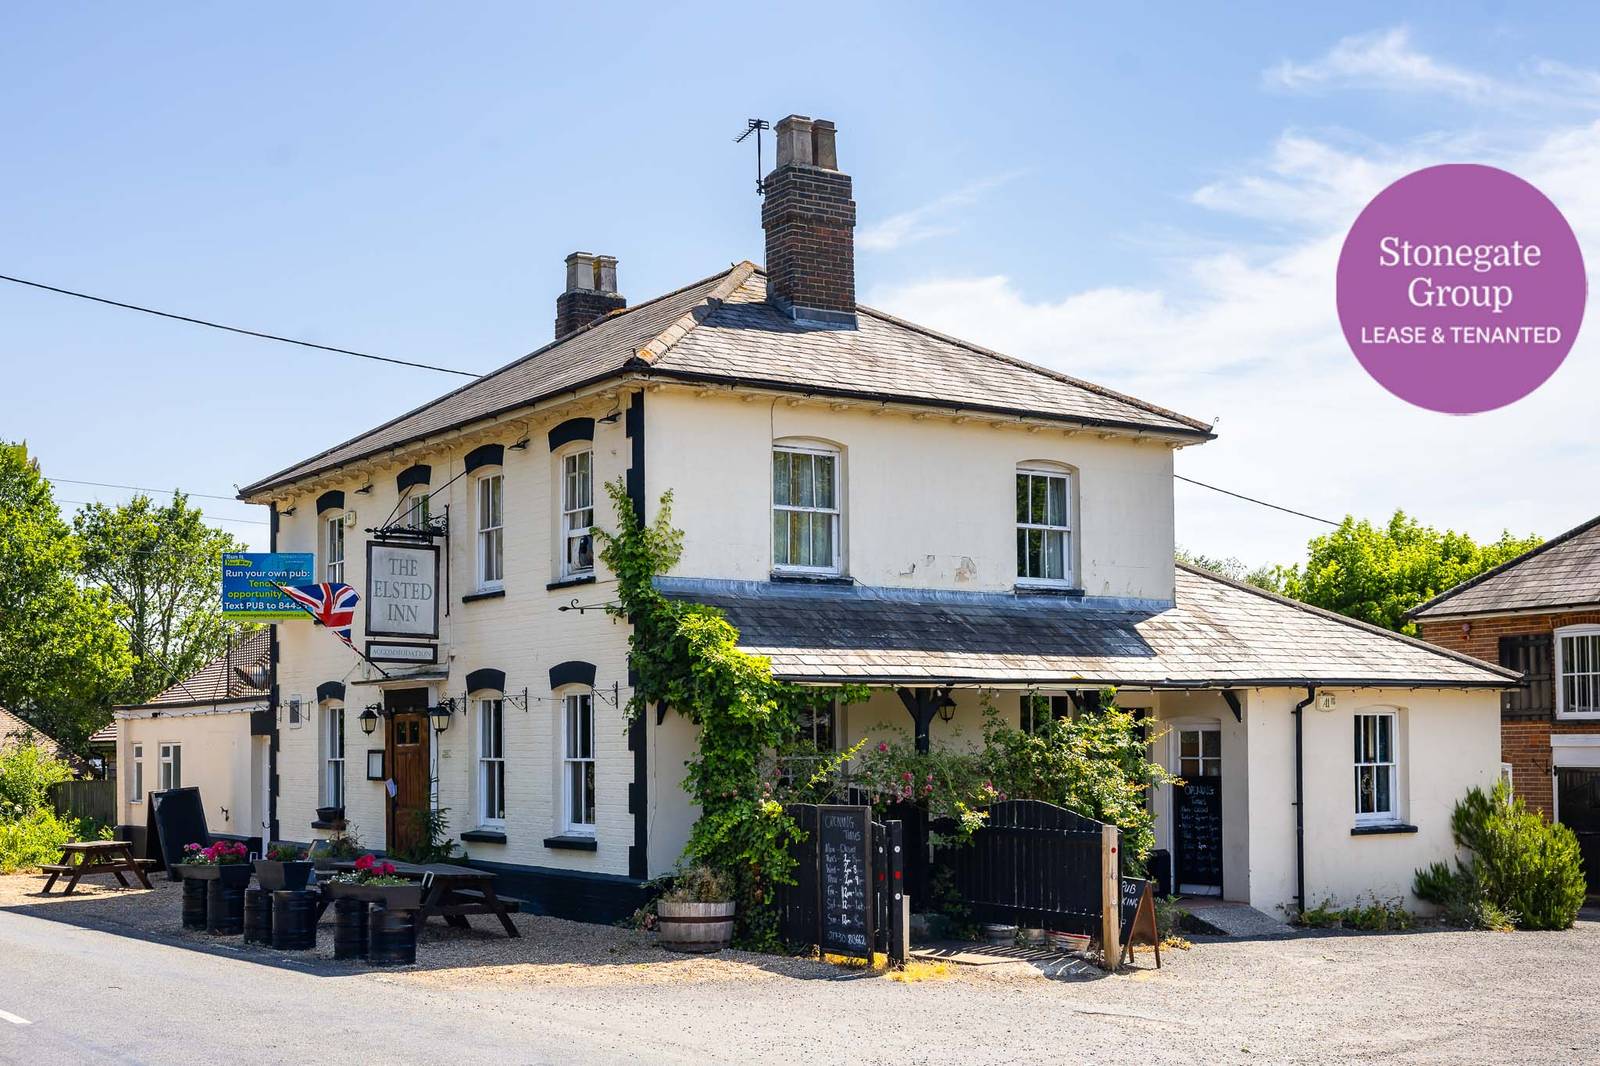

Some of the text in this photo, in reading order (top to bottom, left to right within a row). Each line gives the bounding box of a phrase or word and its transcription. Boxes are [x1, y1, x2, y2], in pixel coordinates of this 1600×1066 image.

[389, 558, 418, 577] THE
[245, 571, 266, 579] your
[289, 570, 311, 579] pub:
[249, 580, 287, 588] Tenacy
[228, 590, 283, 599] opportunity
[373, 580, 432, 601] ELSTED
[387, 603, 419, 622] INN
[372, 647, 432, 658] ACCOMMODATION
